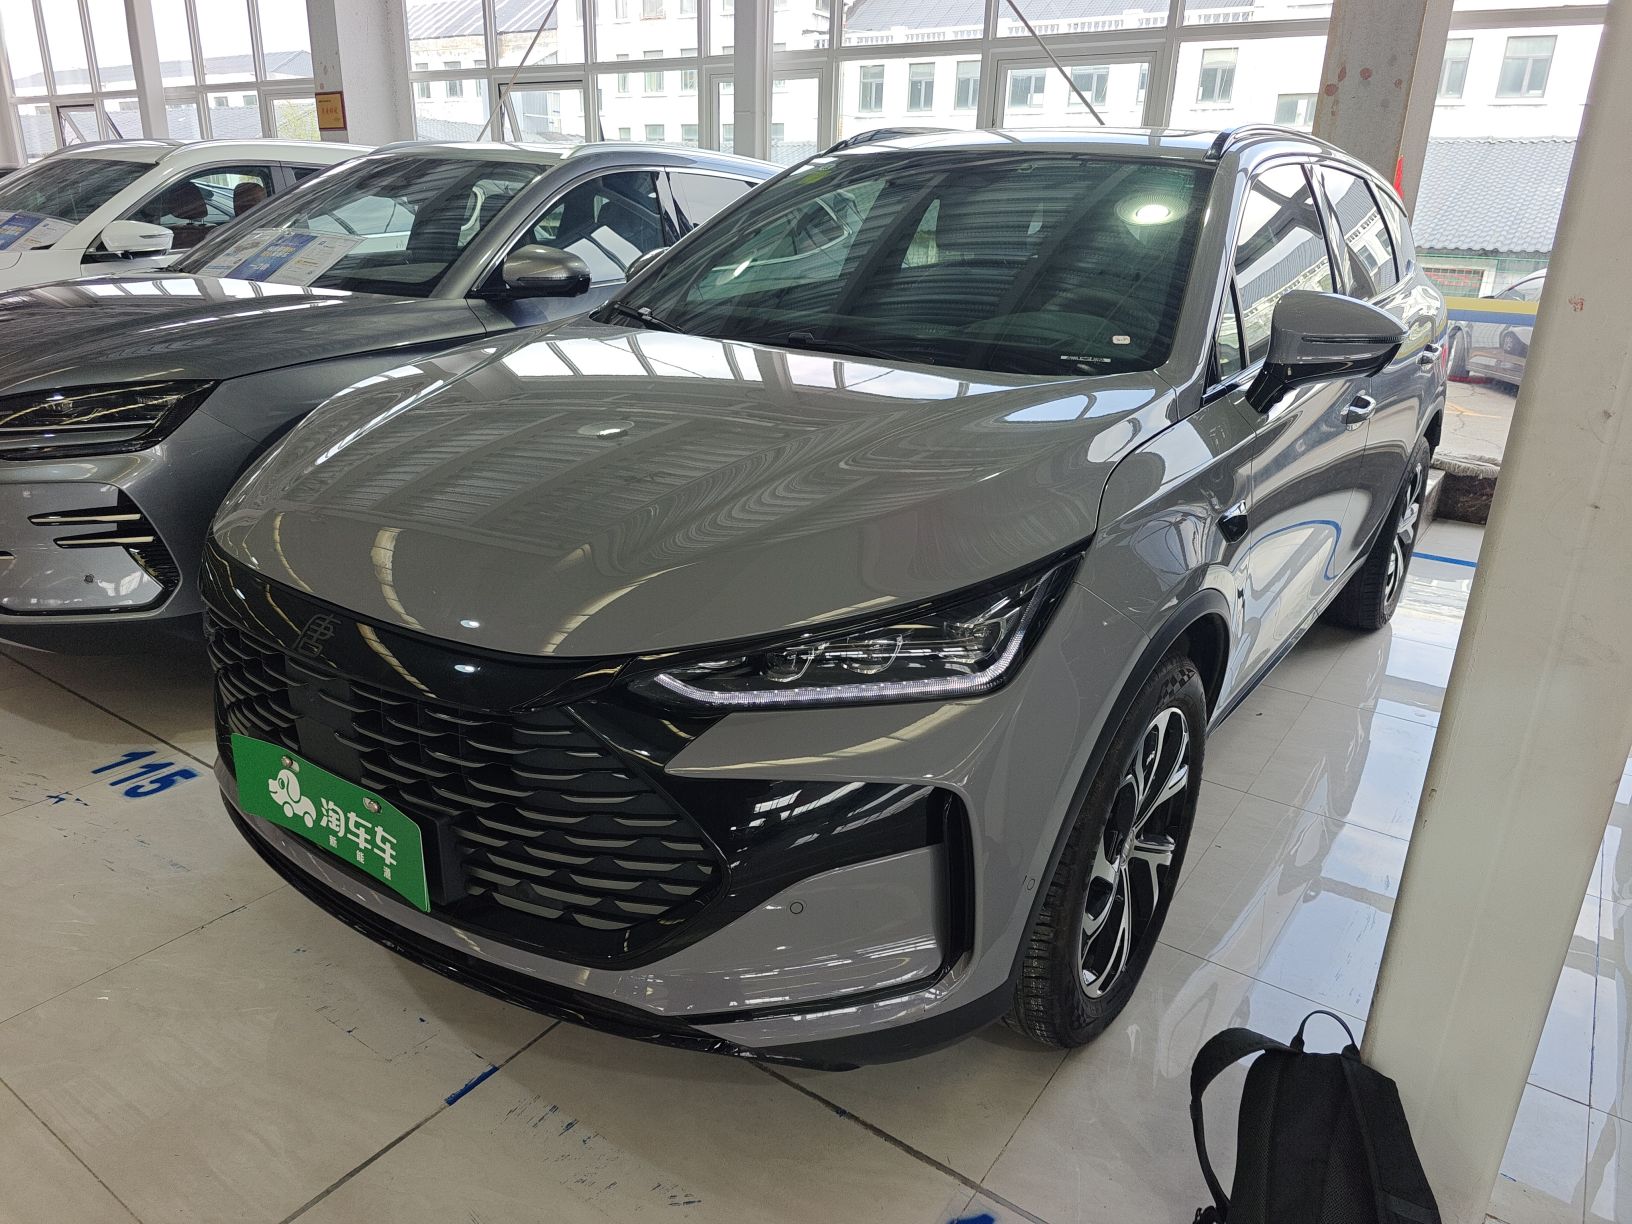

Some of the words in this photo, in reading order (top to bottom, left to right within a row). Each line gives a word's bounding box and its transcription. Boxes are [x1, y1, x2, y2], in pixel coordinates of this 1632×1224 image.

[90, 750, 199, 798] 115
[320, 797, 397, 866] 淘车车
